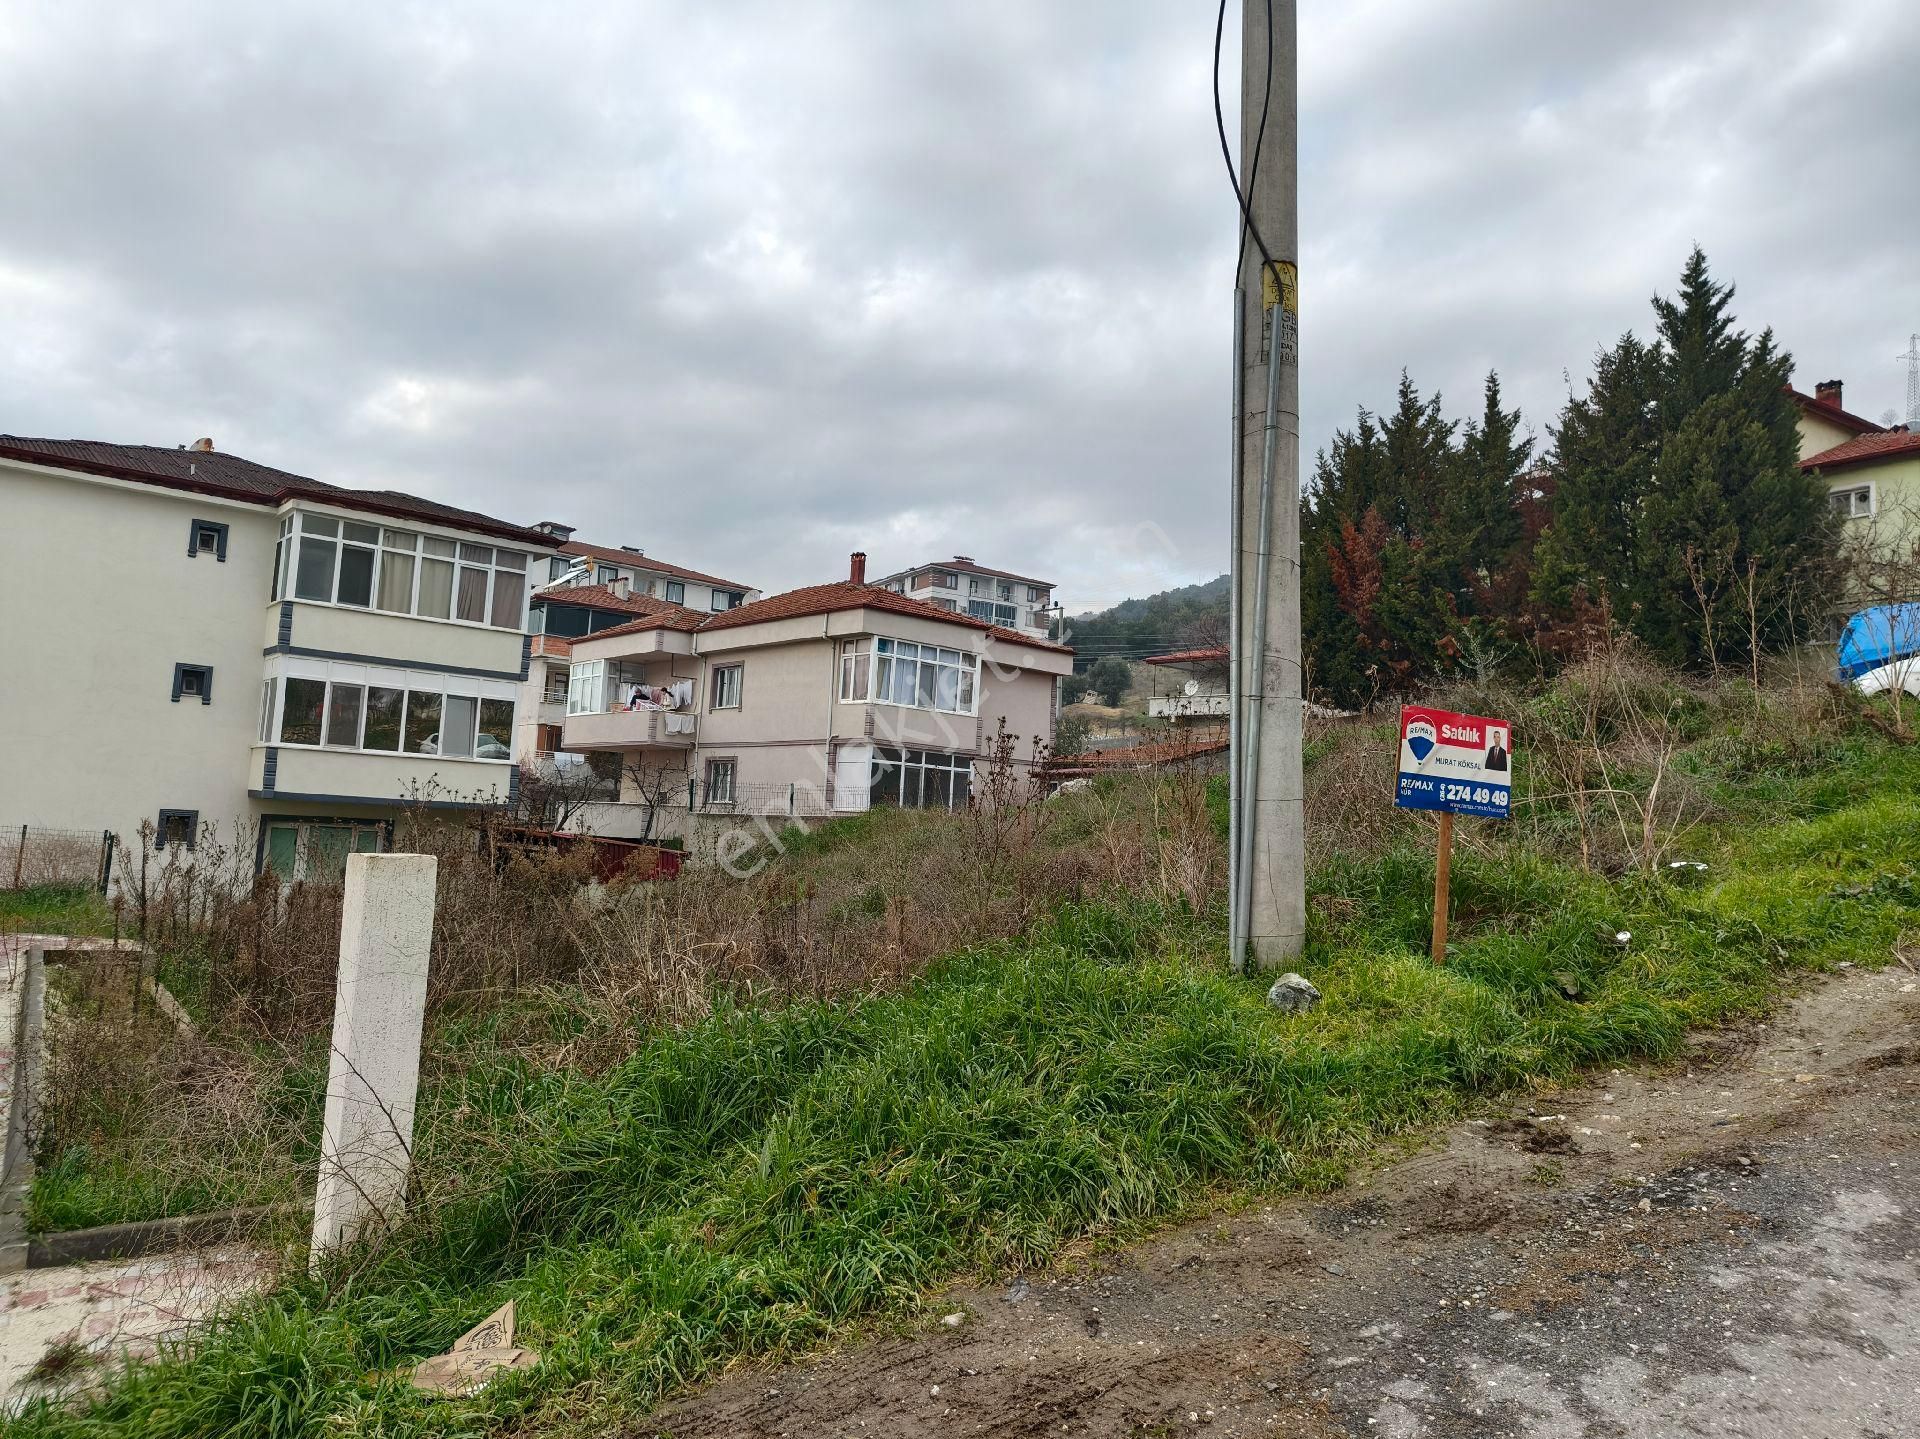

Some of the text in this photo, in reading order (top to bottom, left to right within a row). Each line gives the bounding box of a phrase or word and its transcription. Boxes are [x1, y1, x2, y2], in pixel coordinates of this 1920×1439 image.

[1410, 727, 1433, 737] RE/MAX
[1441, 724, 1480, 743] Satılık
[1435, 757, 1481, 769] MURAT KÖKSAL
[1401, 778, 1434, 791] RE/MAX
[1446, 784, 1471, 801] 274
[1473, 788, 1489, 803] 49
[1492, 790, 1508, 806] 49
